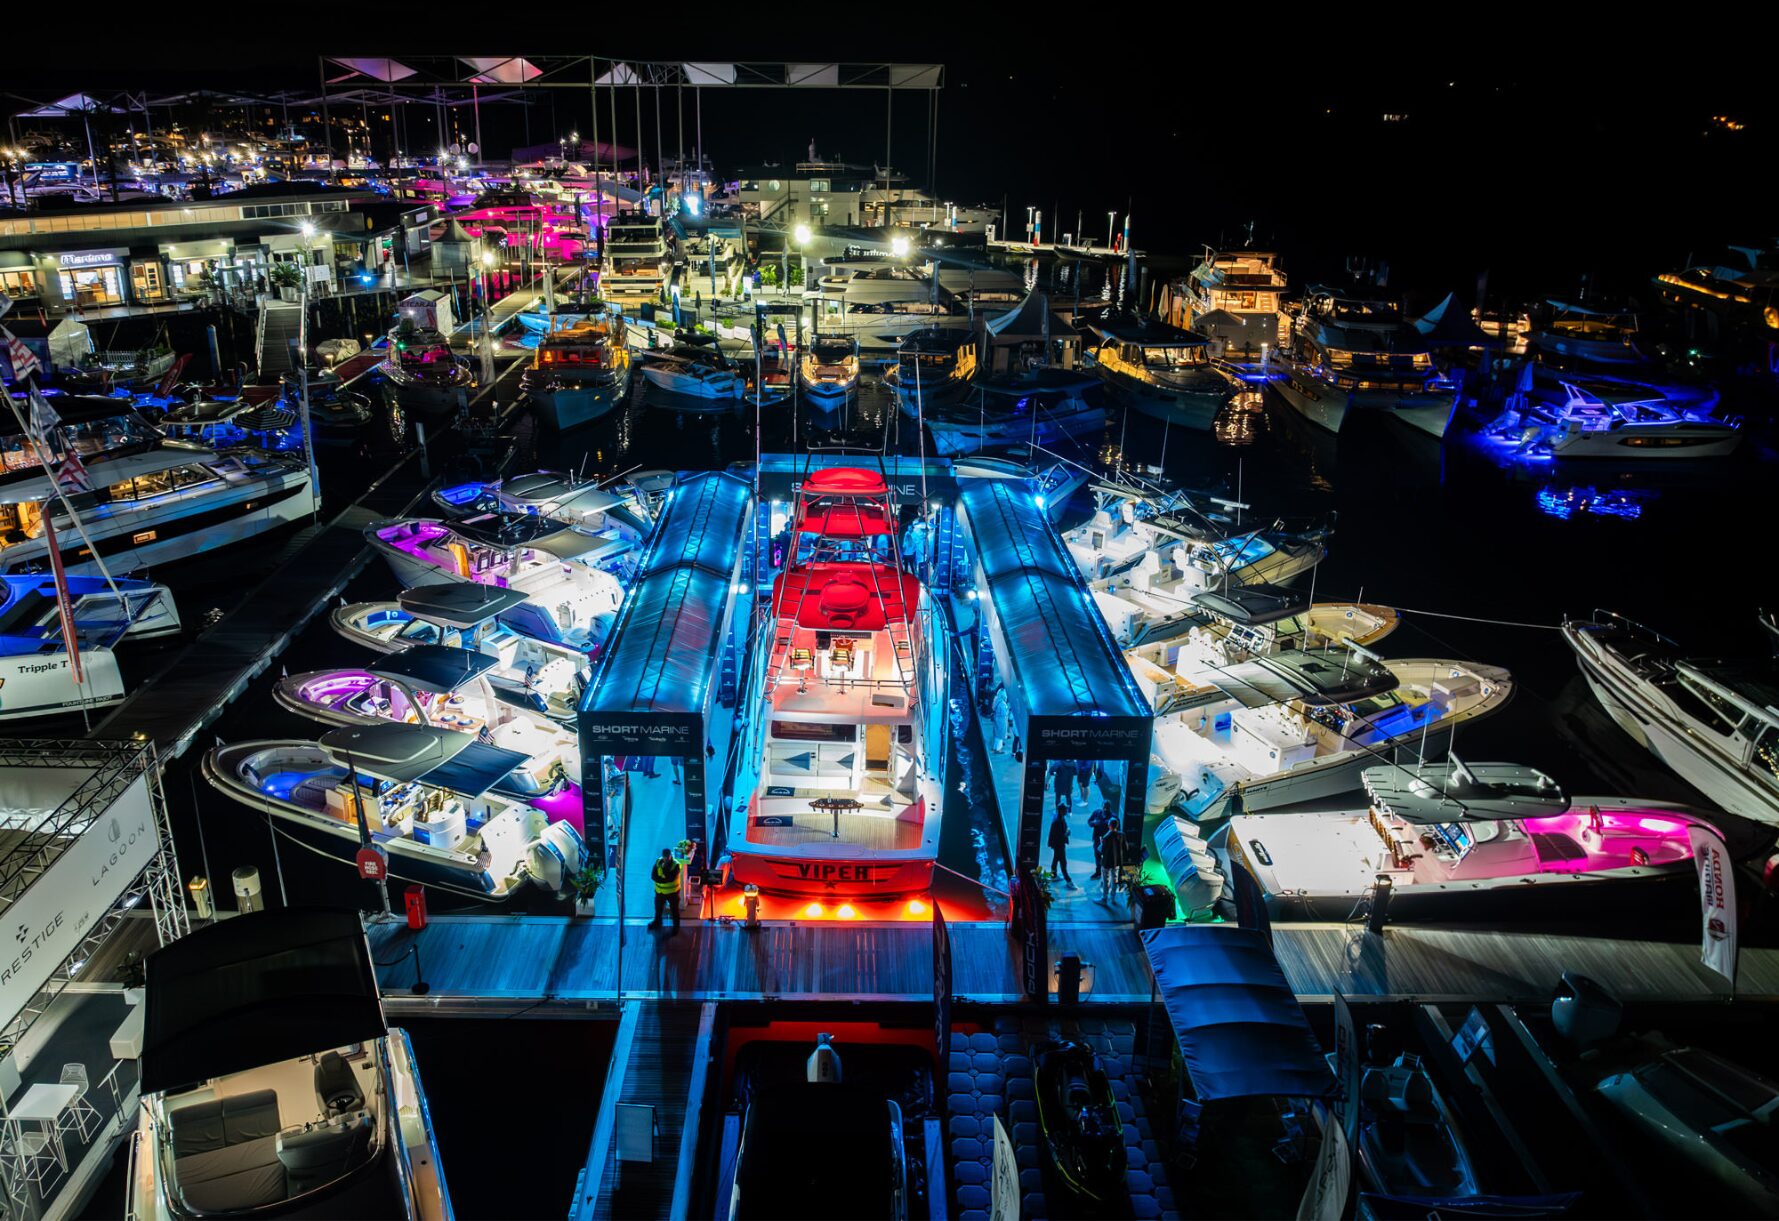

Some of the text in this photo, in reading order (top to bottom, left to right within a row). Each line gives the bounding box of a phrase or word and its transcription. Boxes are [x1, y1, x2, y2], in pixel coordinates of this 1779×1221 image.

[18, 662, 58, 674] Tripple
[92, 822, 146, 887] LAGOON
[799, 863, 870, 880] VIPER
